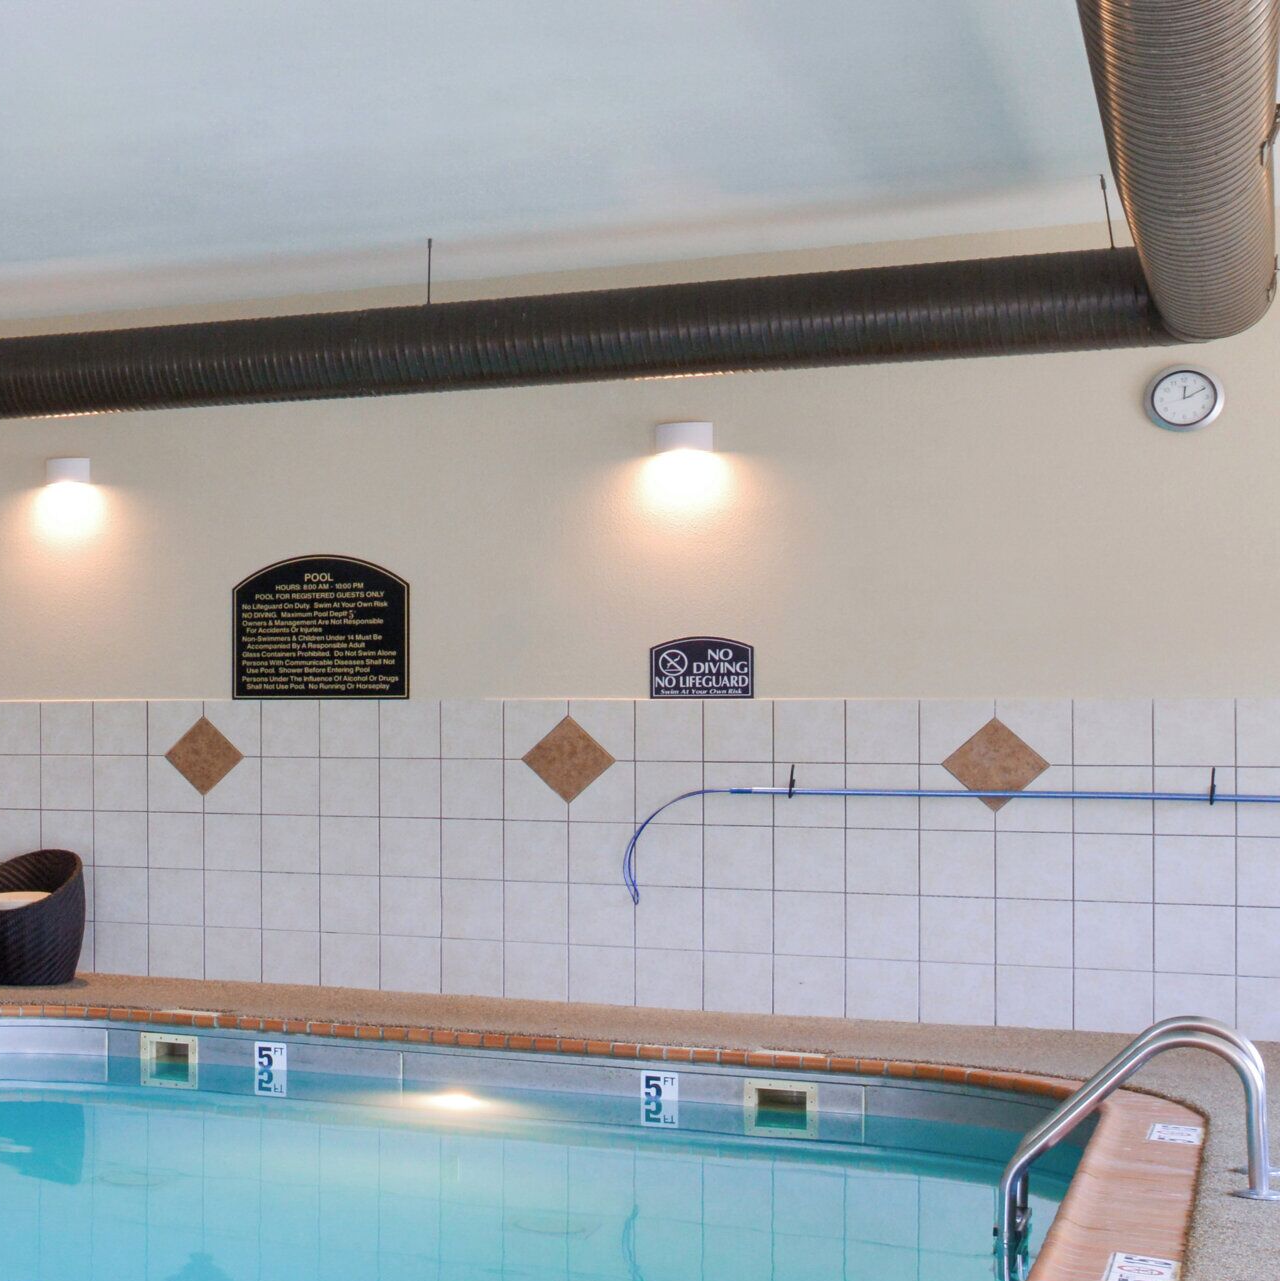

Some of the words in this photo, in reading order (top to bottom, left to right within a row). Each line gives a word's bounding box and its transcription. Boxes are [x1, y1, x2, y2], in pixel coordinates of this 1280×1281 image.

[304, 573, 334, 582] POOL
[252, 603, 282, 611] Lifeguard
[274, 619, 316, 627] Management
[343, 618, 384, 626] Responsible
[300, 626, 322, 634] Injuries
[707, 648, 733, 661] NO
[693, 661, 748, 674] DIVING
[656, 676, 676, 688] NO
[680, 675, 749, 688] LIFEGUARD
[258, 1046, 273, 1069] 5
[645, 1075, 662, 1100] 5
[664, 1076, 675, 1086] FT
